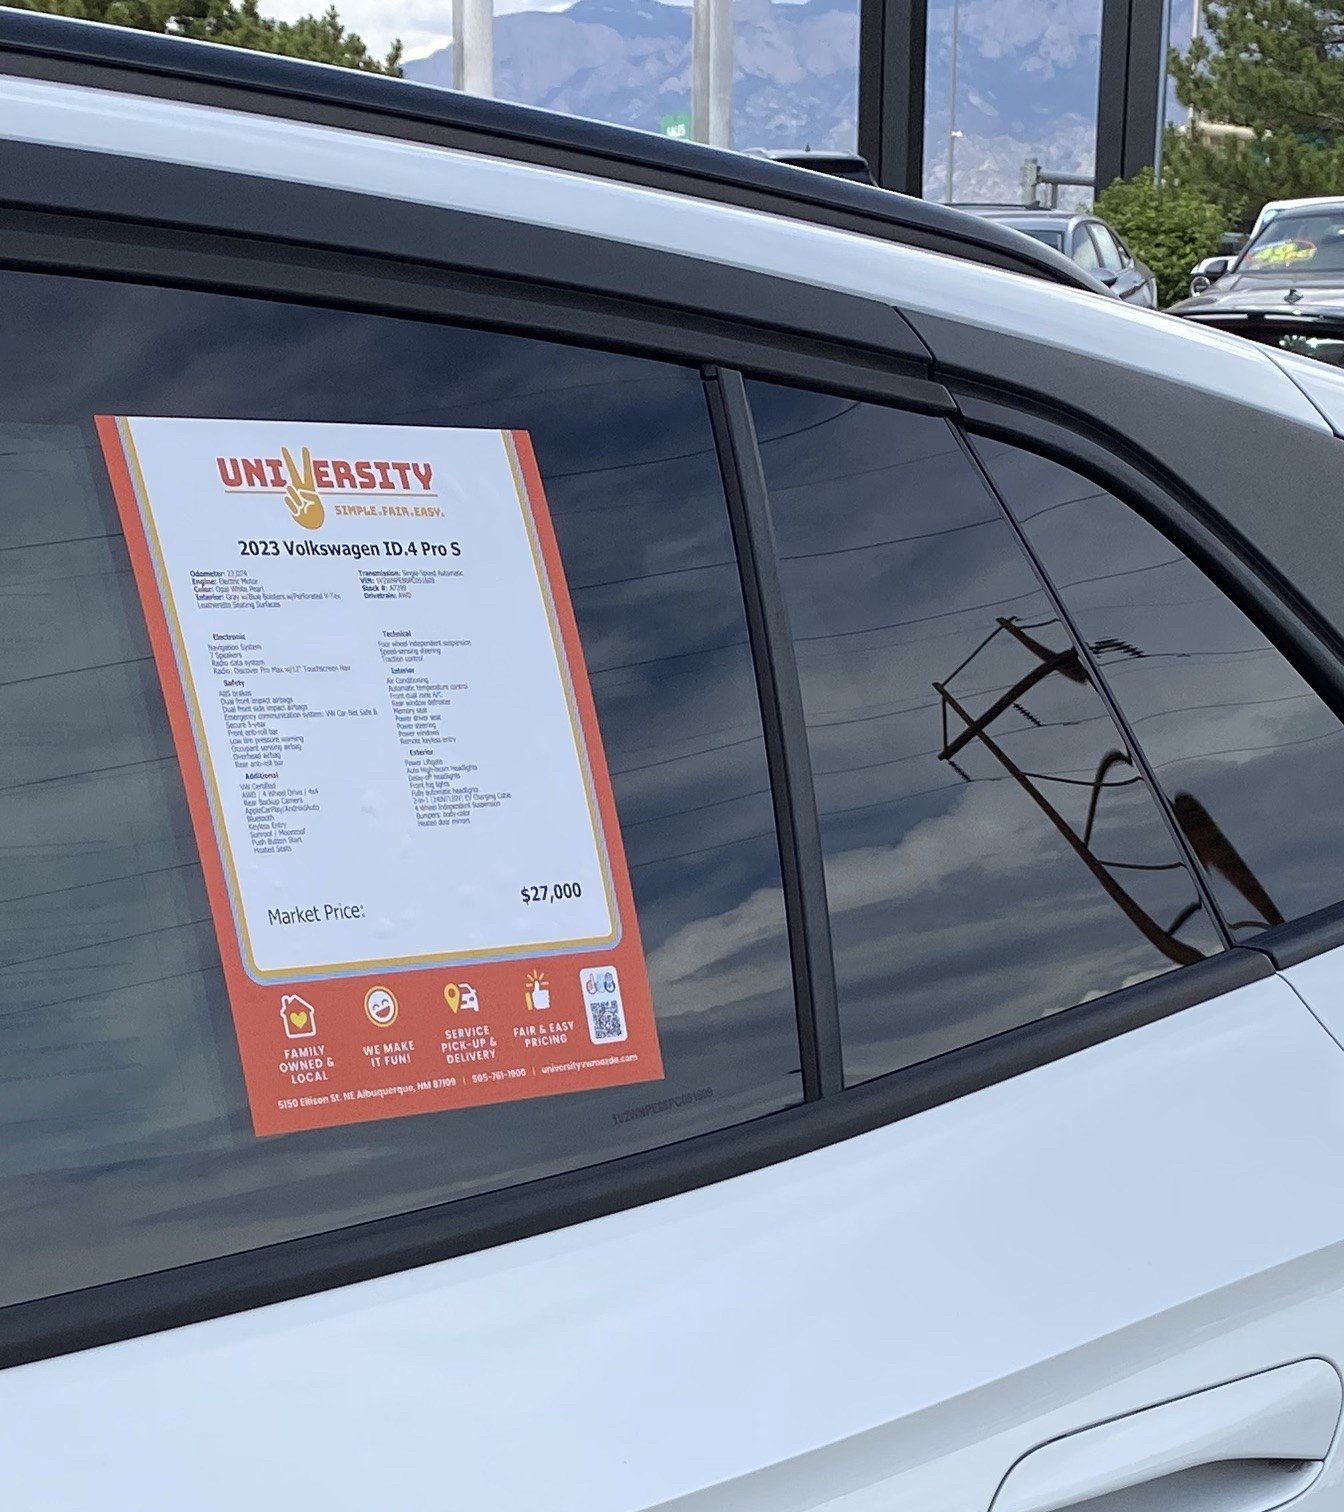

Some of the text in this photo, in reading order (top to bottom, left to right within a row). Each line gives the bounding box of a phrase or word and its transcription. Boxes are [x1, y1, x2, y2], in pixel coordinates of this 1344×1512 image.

[238, 540, 461, 560] 2023 Volkswagen ID.4 Pro S
[521, 882, 582, 905] $27,000
[268, 903, 365, 926] Market Price:
[445, 1025, 489, 1039] SERVICE
[513, 1021, 573, 1037] FAIR & EASY
[441, 1037, 497, 1052] PICK-UP &
[525, 1034, 567, 1047] PRICING
[284, 1045, 324, 1059] FAMILY
[363, 1041, 414, 1056] WE MAKE
[371, 1054, 410, 1067] IT FUN!
[447, 1049, 495, 1064] DELIVERY
[279, 1057, 334, 1073] OWNED &
[291, 1071, 328, 1084] LOCAL
[278, 1099, 298, 1109] 5150
[330, 1094, 342, 1102] St.
[343, 1091, 355, 1100] NE
[417, 1081, 431, 1090] NM
